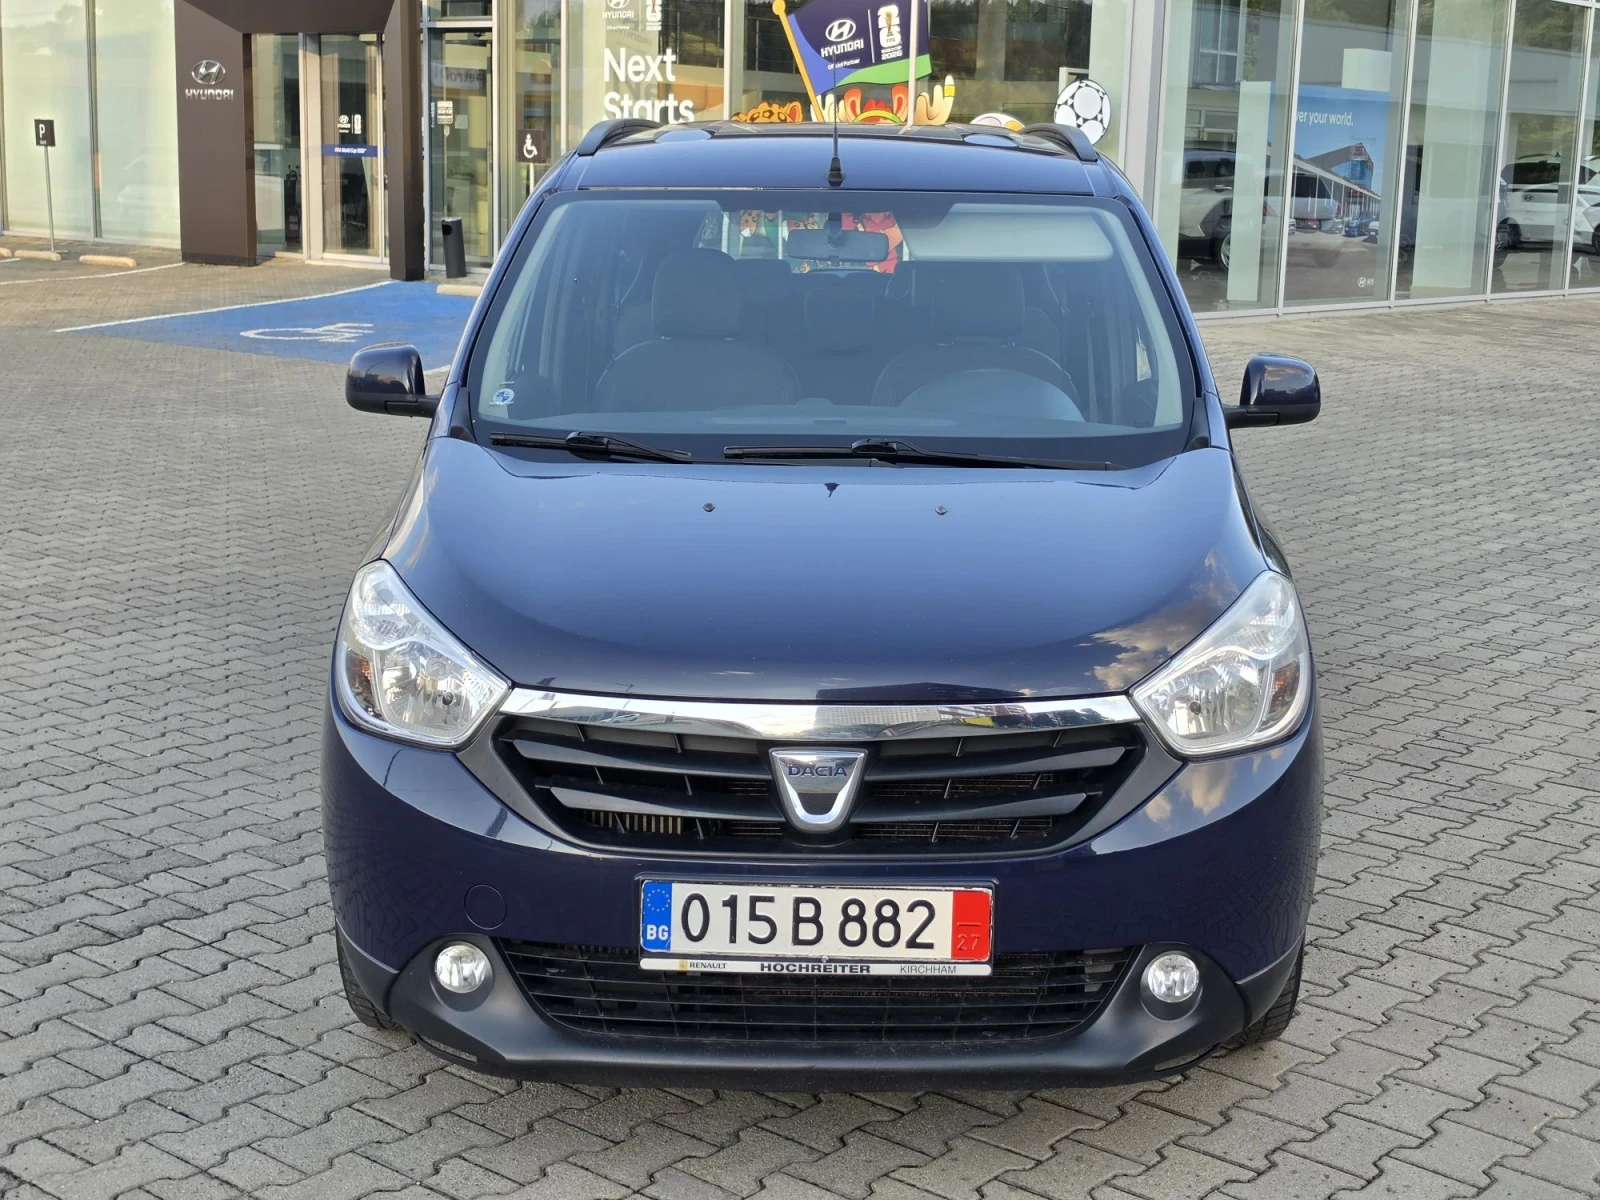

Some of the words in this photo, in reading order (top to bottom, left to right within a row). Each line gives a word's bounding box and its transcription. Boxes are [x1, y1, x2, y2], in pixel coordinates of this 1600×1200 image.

[602, 11, 635, 19] HYUNDAI
[820, 39, 864, 57] HYUNDAI
[603, 47, 677, 82] Next
[185, 88, 234, 100] HYUNDAI
[602, 91, 696, 124] Starts
[1309, 111, 1328, 126] your
[1328, 112, 1354, 126] world.
[39, 123, 46, 138] P
[788, 765, 847, 777] DACIA
[646, 924, 669, 941] BG
[957, 933, 981, 951] 27
[689, 962, 727, 970] RENAULT
[760, 963, 871, 974] HOCHREITER
[900, 965, 957, 975] KIRCHHAM
